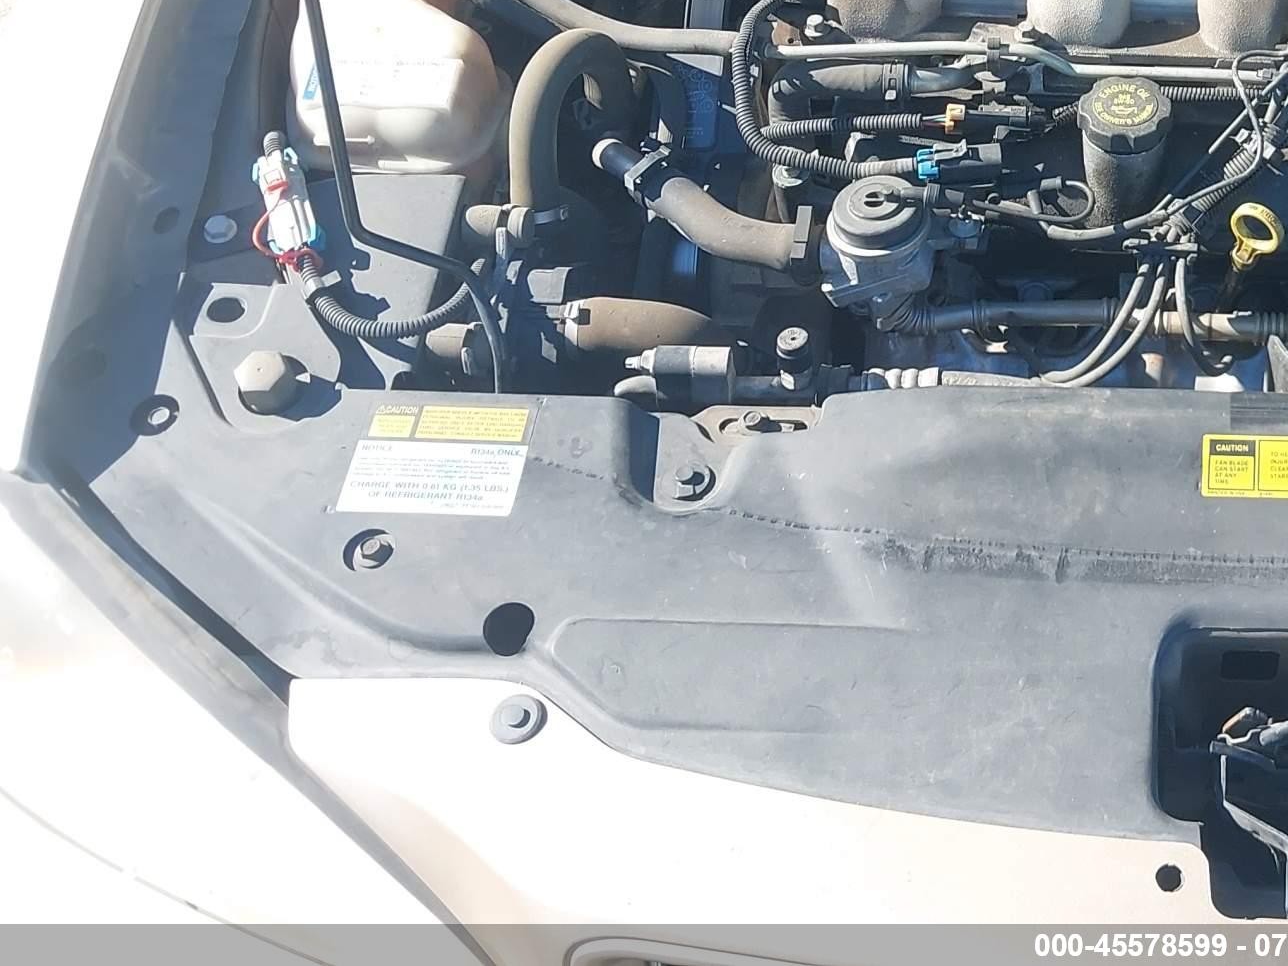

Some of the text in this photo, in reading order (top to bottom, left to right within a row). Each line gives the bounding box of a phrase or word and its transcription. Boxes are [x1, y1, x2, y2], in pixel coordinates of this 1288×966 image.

[1098, 83, 1150, 101] ENGINE OIL
[386, 406, 418, 414] CAUTION
[1215, 444, 1249, 452] CAUTION
[350, 481, 390, 489] CHARGE
[394, 481, 420, 489] WITH
[384, 491, 452, 500] REFRIGERANT
